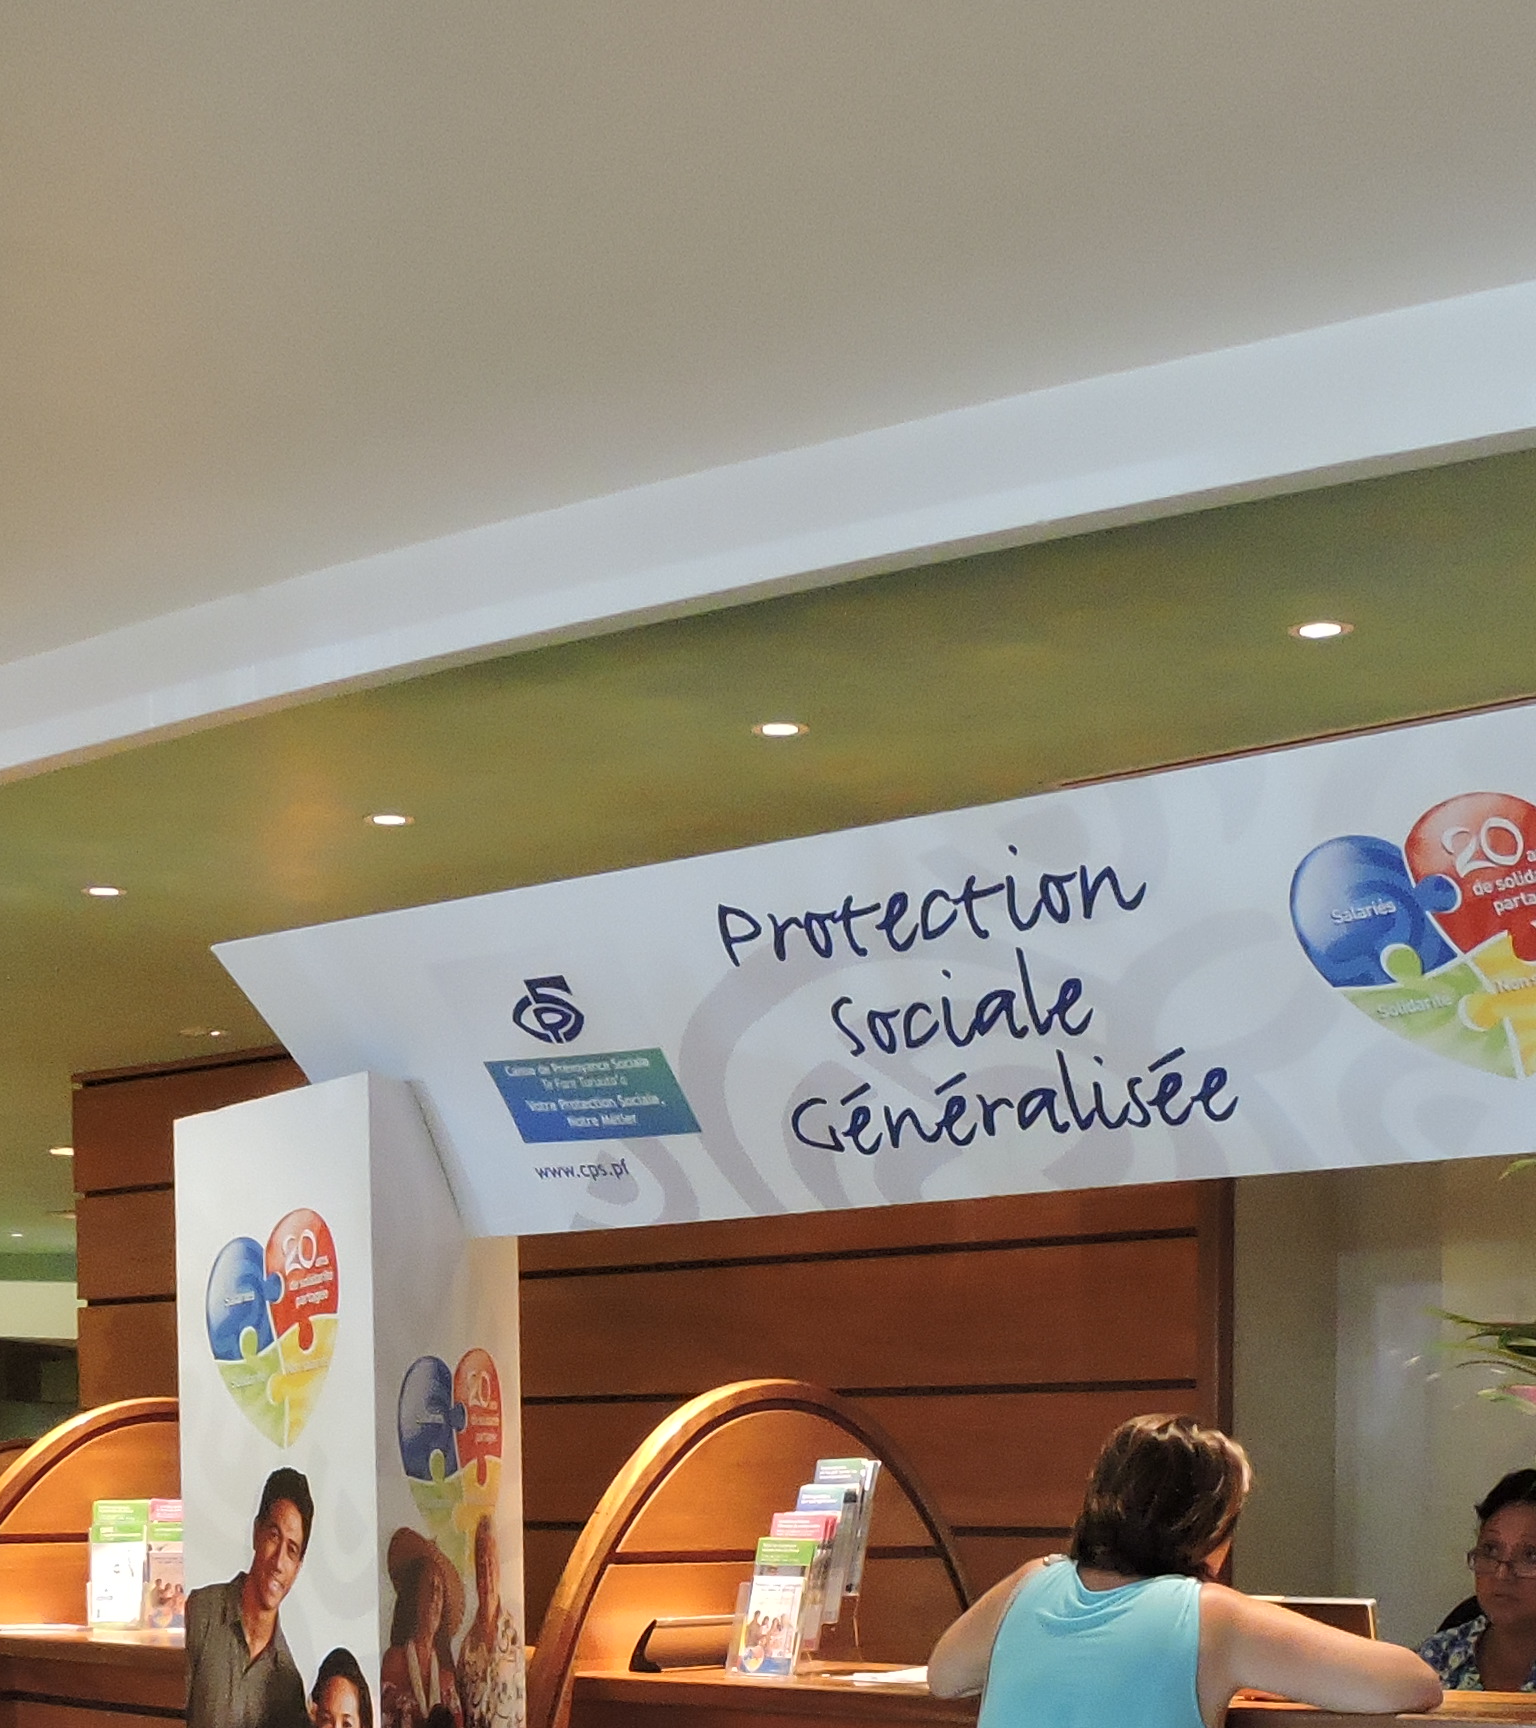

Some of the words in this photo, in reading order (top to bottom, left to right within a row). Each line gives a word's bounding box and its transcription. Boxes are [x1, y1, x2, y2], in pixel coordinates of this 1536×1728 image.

[1441, 817, 1524, 878] 20
[718, 845, 1147, 966] Protection
[1473, 879, 1493, 896] de
[1331, 898, 1396, 924] Salariés
[791, 1047, 1239, 1155] Généralisée
[535, 1158, 629, 1181] www.cps.pf
